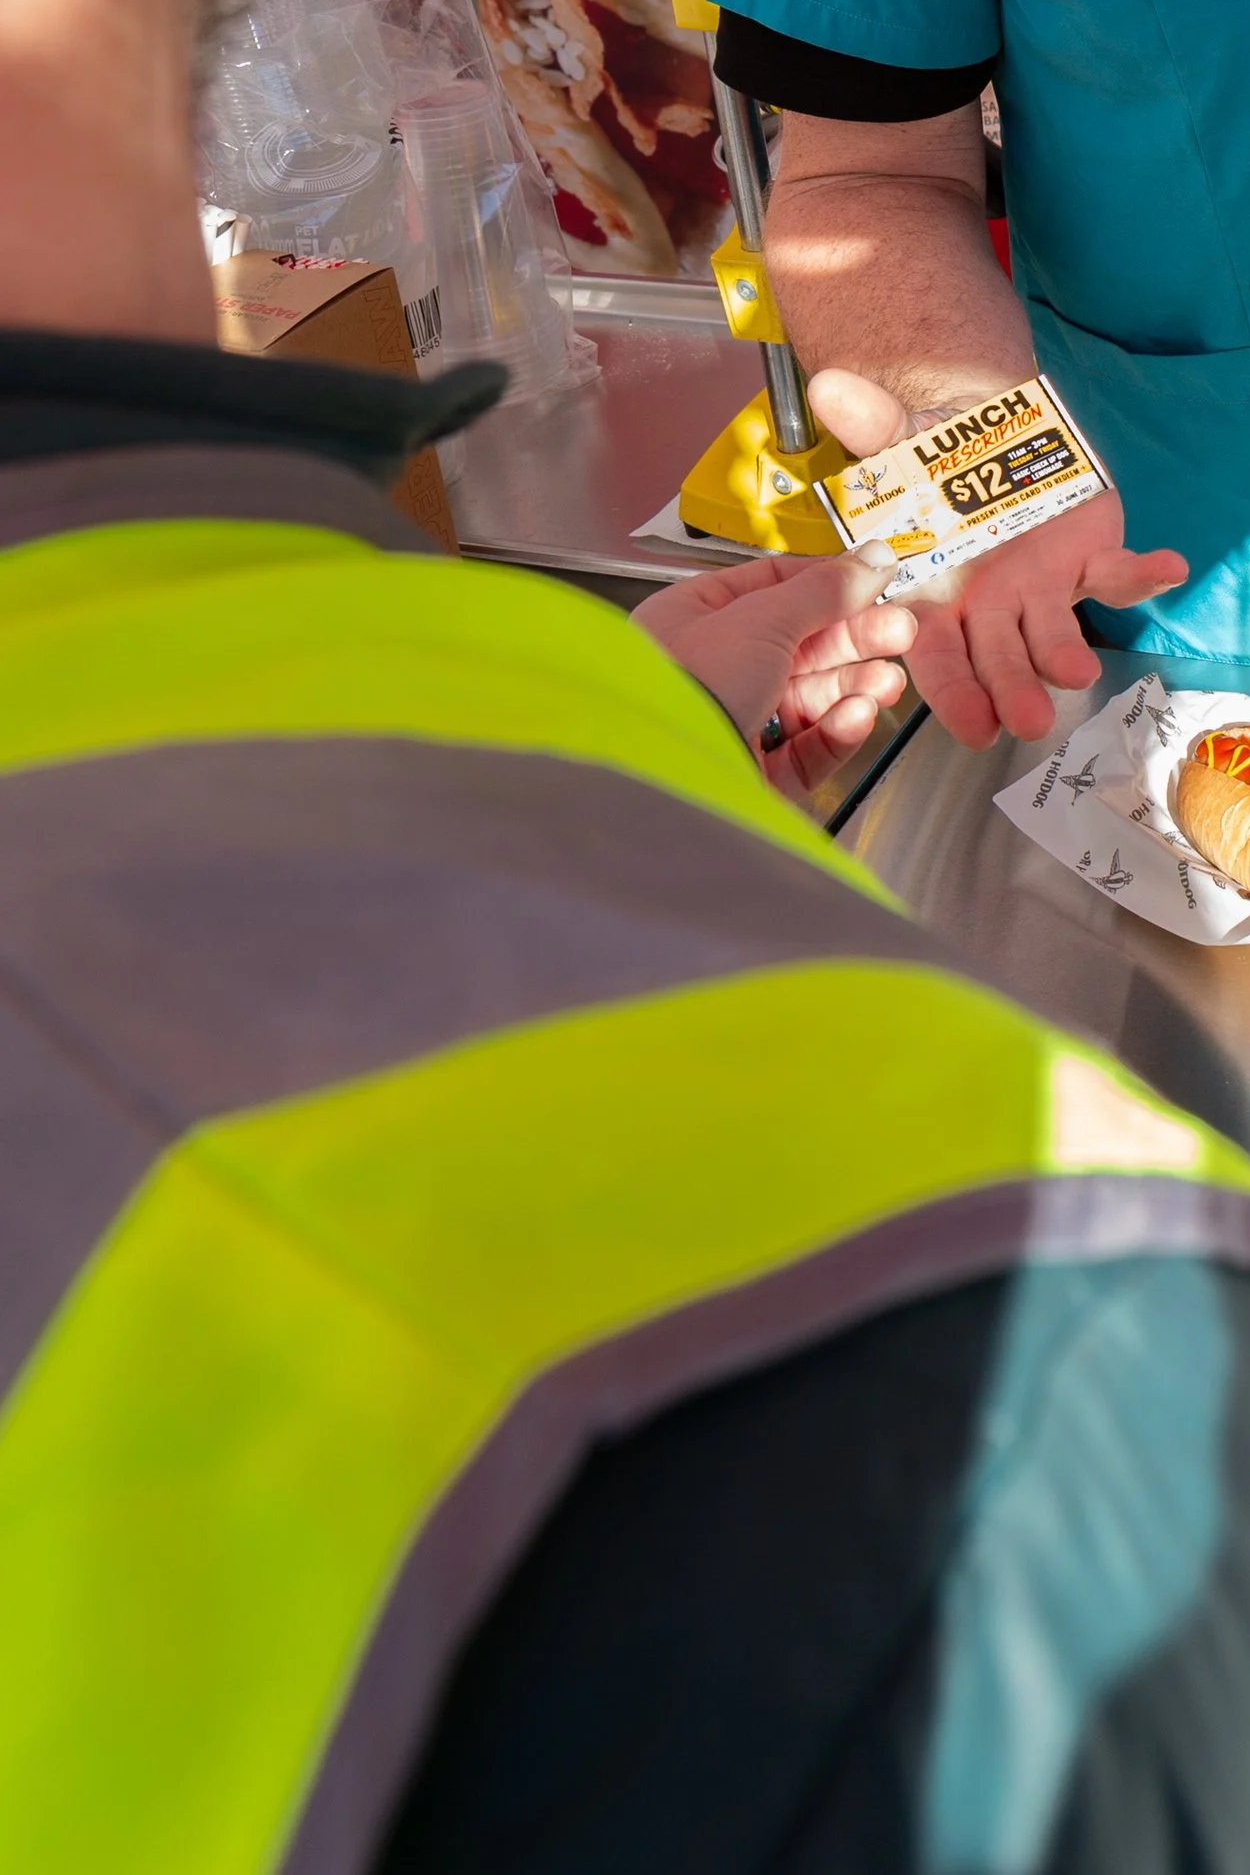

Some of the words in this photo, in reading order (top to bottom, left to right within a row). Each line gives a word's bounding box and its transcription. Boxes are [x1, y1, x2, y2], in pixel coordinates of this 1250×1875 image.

[913, 389, 1032, 466] LUNCH
[927, 403, 1042, 481] PRESCRIPTION
[848, 505, 865, 520] DR
[865, 485, 906, 511] HOTDOG
[950, 461, 1013, 504] $12
[966, 508, 999, 528] PRESENT
[1000, 498, 1019, 513] THIS
[1019, 487, 1041, 503] CARD
[1042, 481, 1053, 491] TO
[1054, 468, 1080, 485] REDEEM
[1032, 760, 1062, 809] HOTDOG
